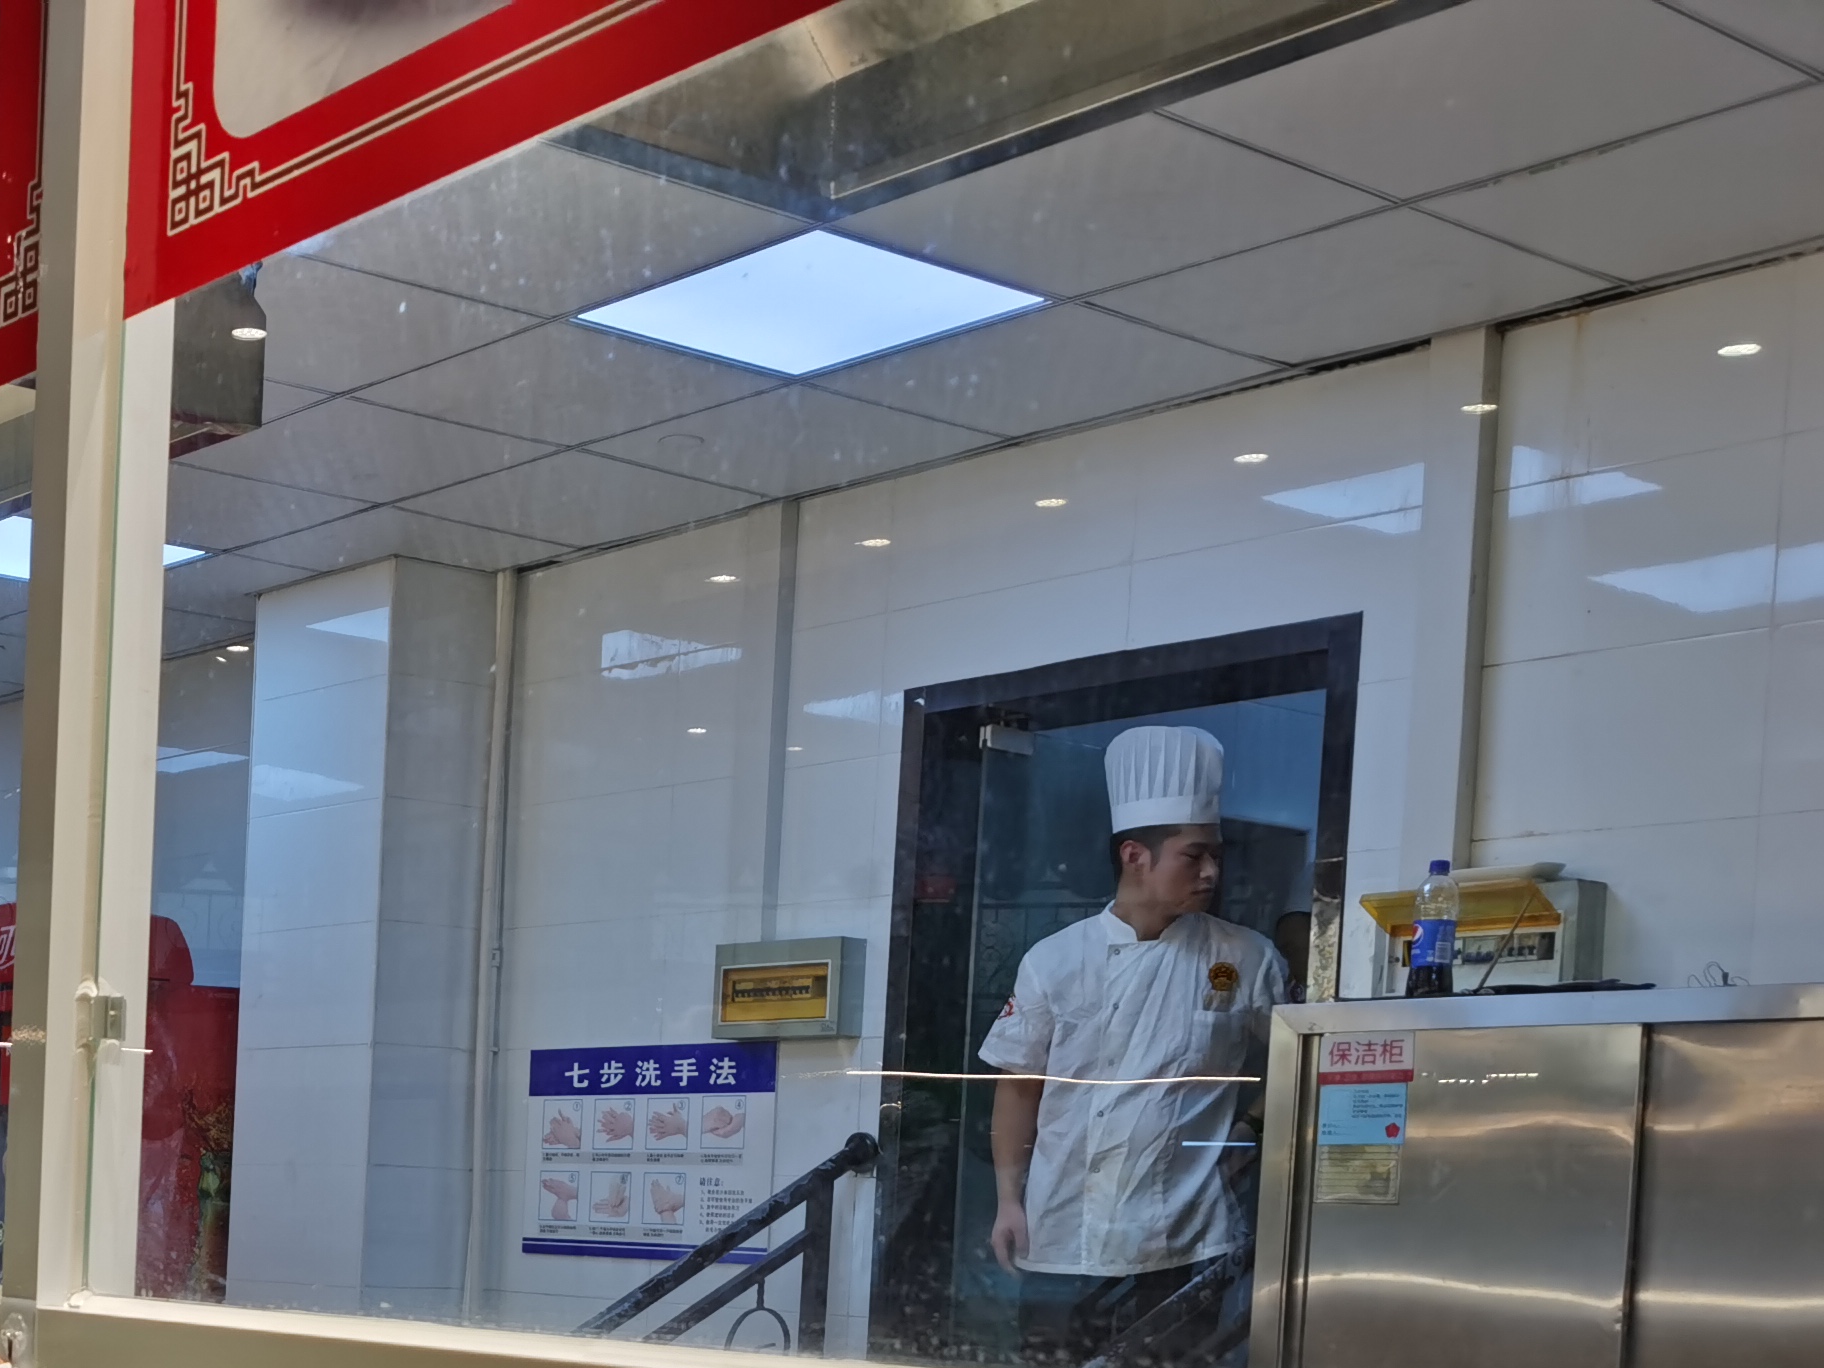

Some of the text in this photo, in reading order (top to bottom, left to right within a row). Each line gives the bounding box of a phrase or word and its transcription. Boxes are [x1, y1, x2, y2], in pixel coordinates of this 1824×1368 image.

[1328, 1038, 1405, 1067] 保洁柜
[564, 1057, 737, 1088] 七步洗手法
